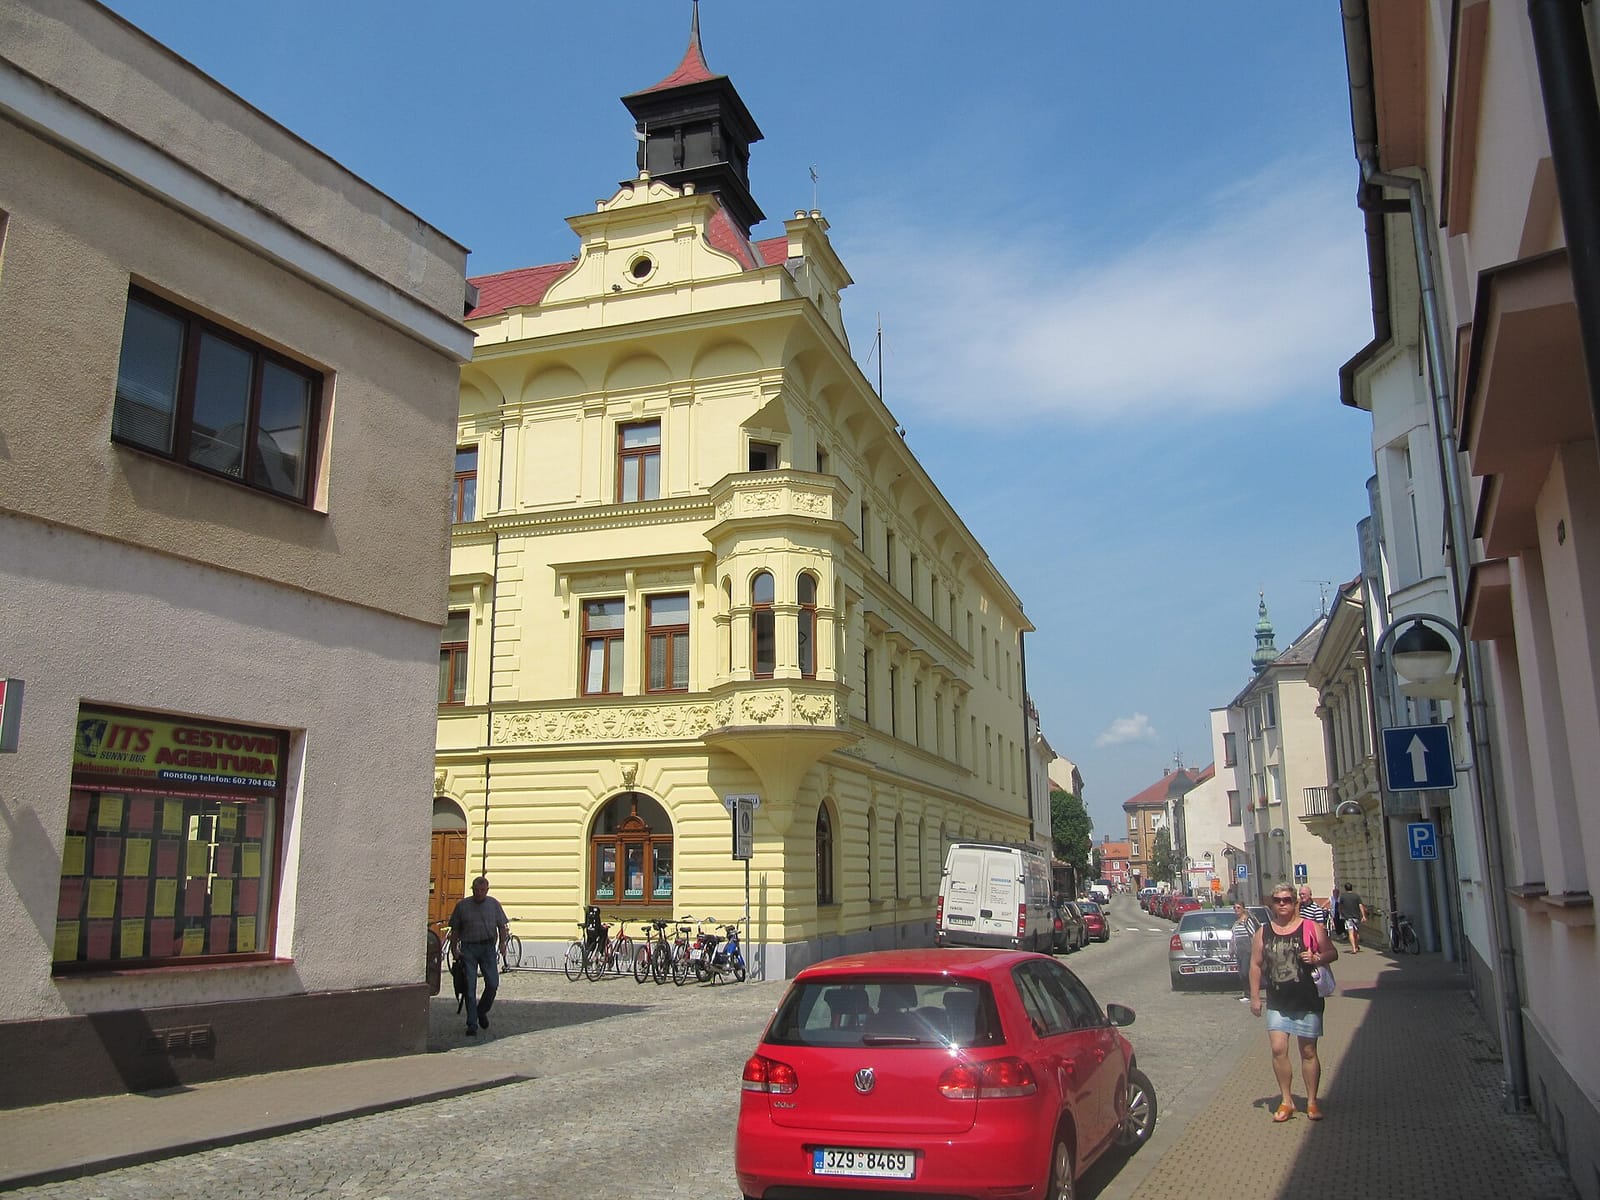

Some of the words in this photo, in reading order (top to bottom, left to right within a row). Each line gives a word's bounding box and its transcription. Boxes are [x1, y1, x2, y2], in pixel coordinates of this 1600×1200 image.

[106, 724, 153, 753] ITS
[100, 751, 128, 761] SUNNY
[155, 747, 275, 775] AGENTURA
[163, 771, 197, 782] nonstop
[199, 774, 232, 784] telefon:
[232, 777, 246, 785] 602
[248, 778, 261, 786] 704
[263, 780, 277, 788] 682
[1413, 828, 1429, 848] P
[827, 1151, 854, 1169] 3Z9
[867, 1152, 906, 1171] 8469
